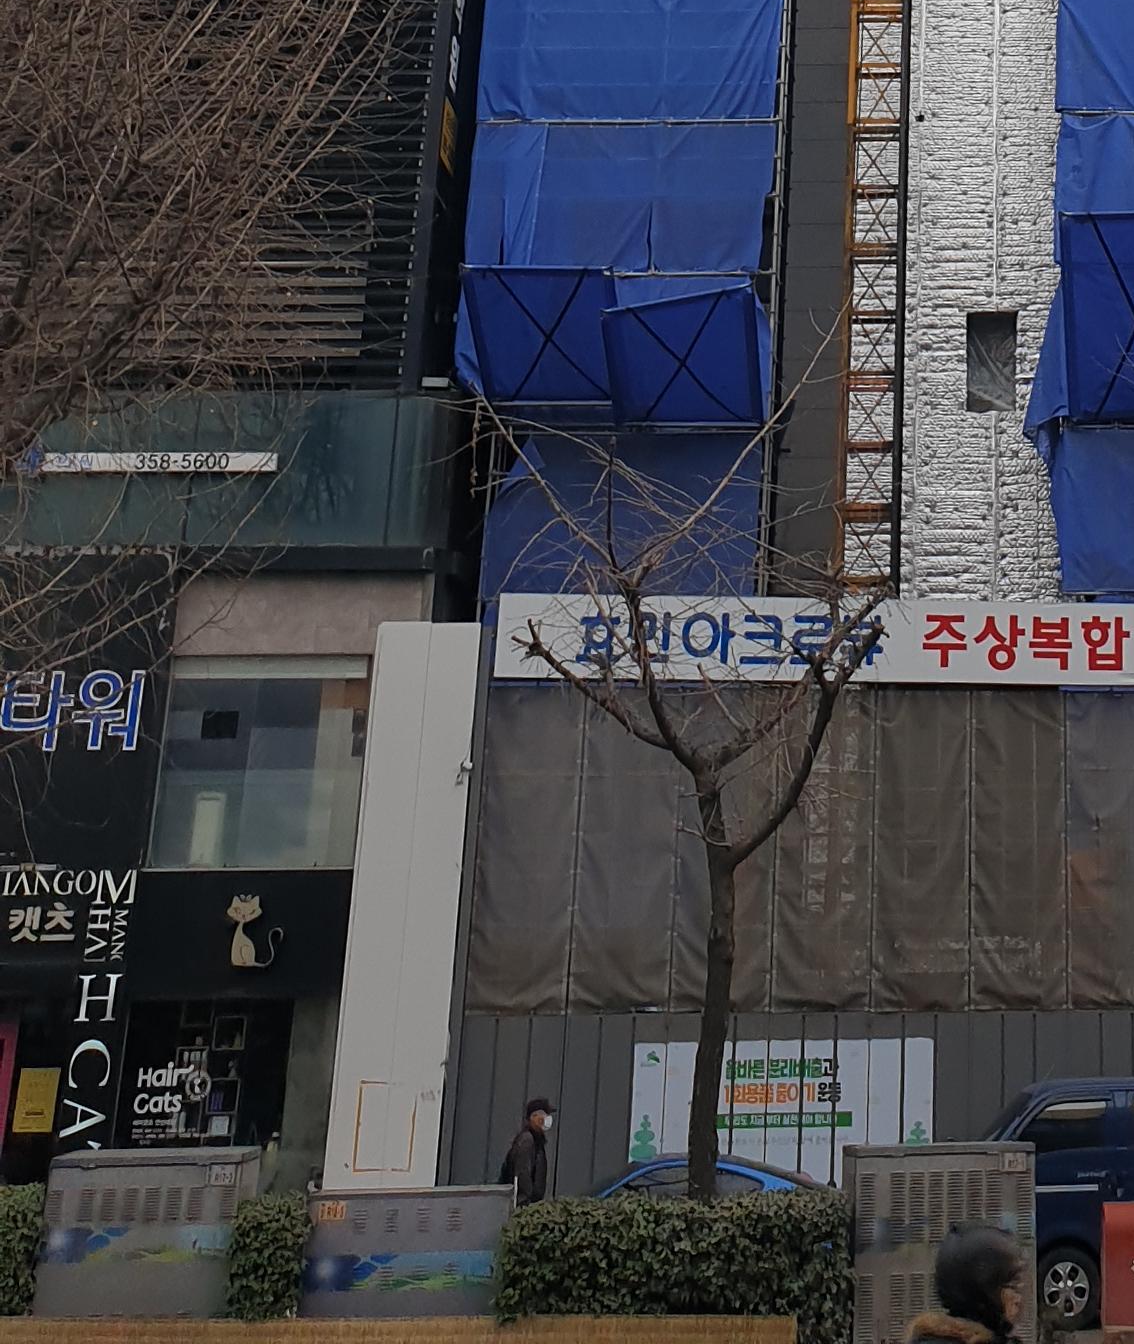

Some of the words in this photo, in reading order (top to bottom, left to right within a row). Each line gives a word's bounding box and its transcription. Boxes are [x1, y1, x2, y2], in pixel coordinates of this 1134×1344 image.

[135, 452, 230, 471] 358-5600
[922, 612, 1130, 673] 주상복합
[1, 669, 146, 751] 타워
[9, 901, 76, 943] 캣츠
[137, 1061, 195, 1088] Hair
[133, 1092, 182, 1115] Cats
